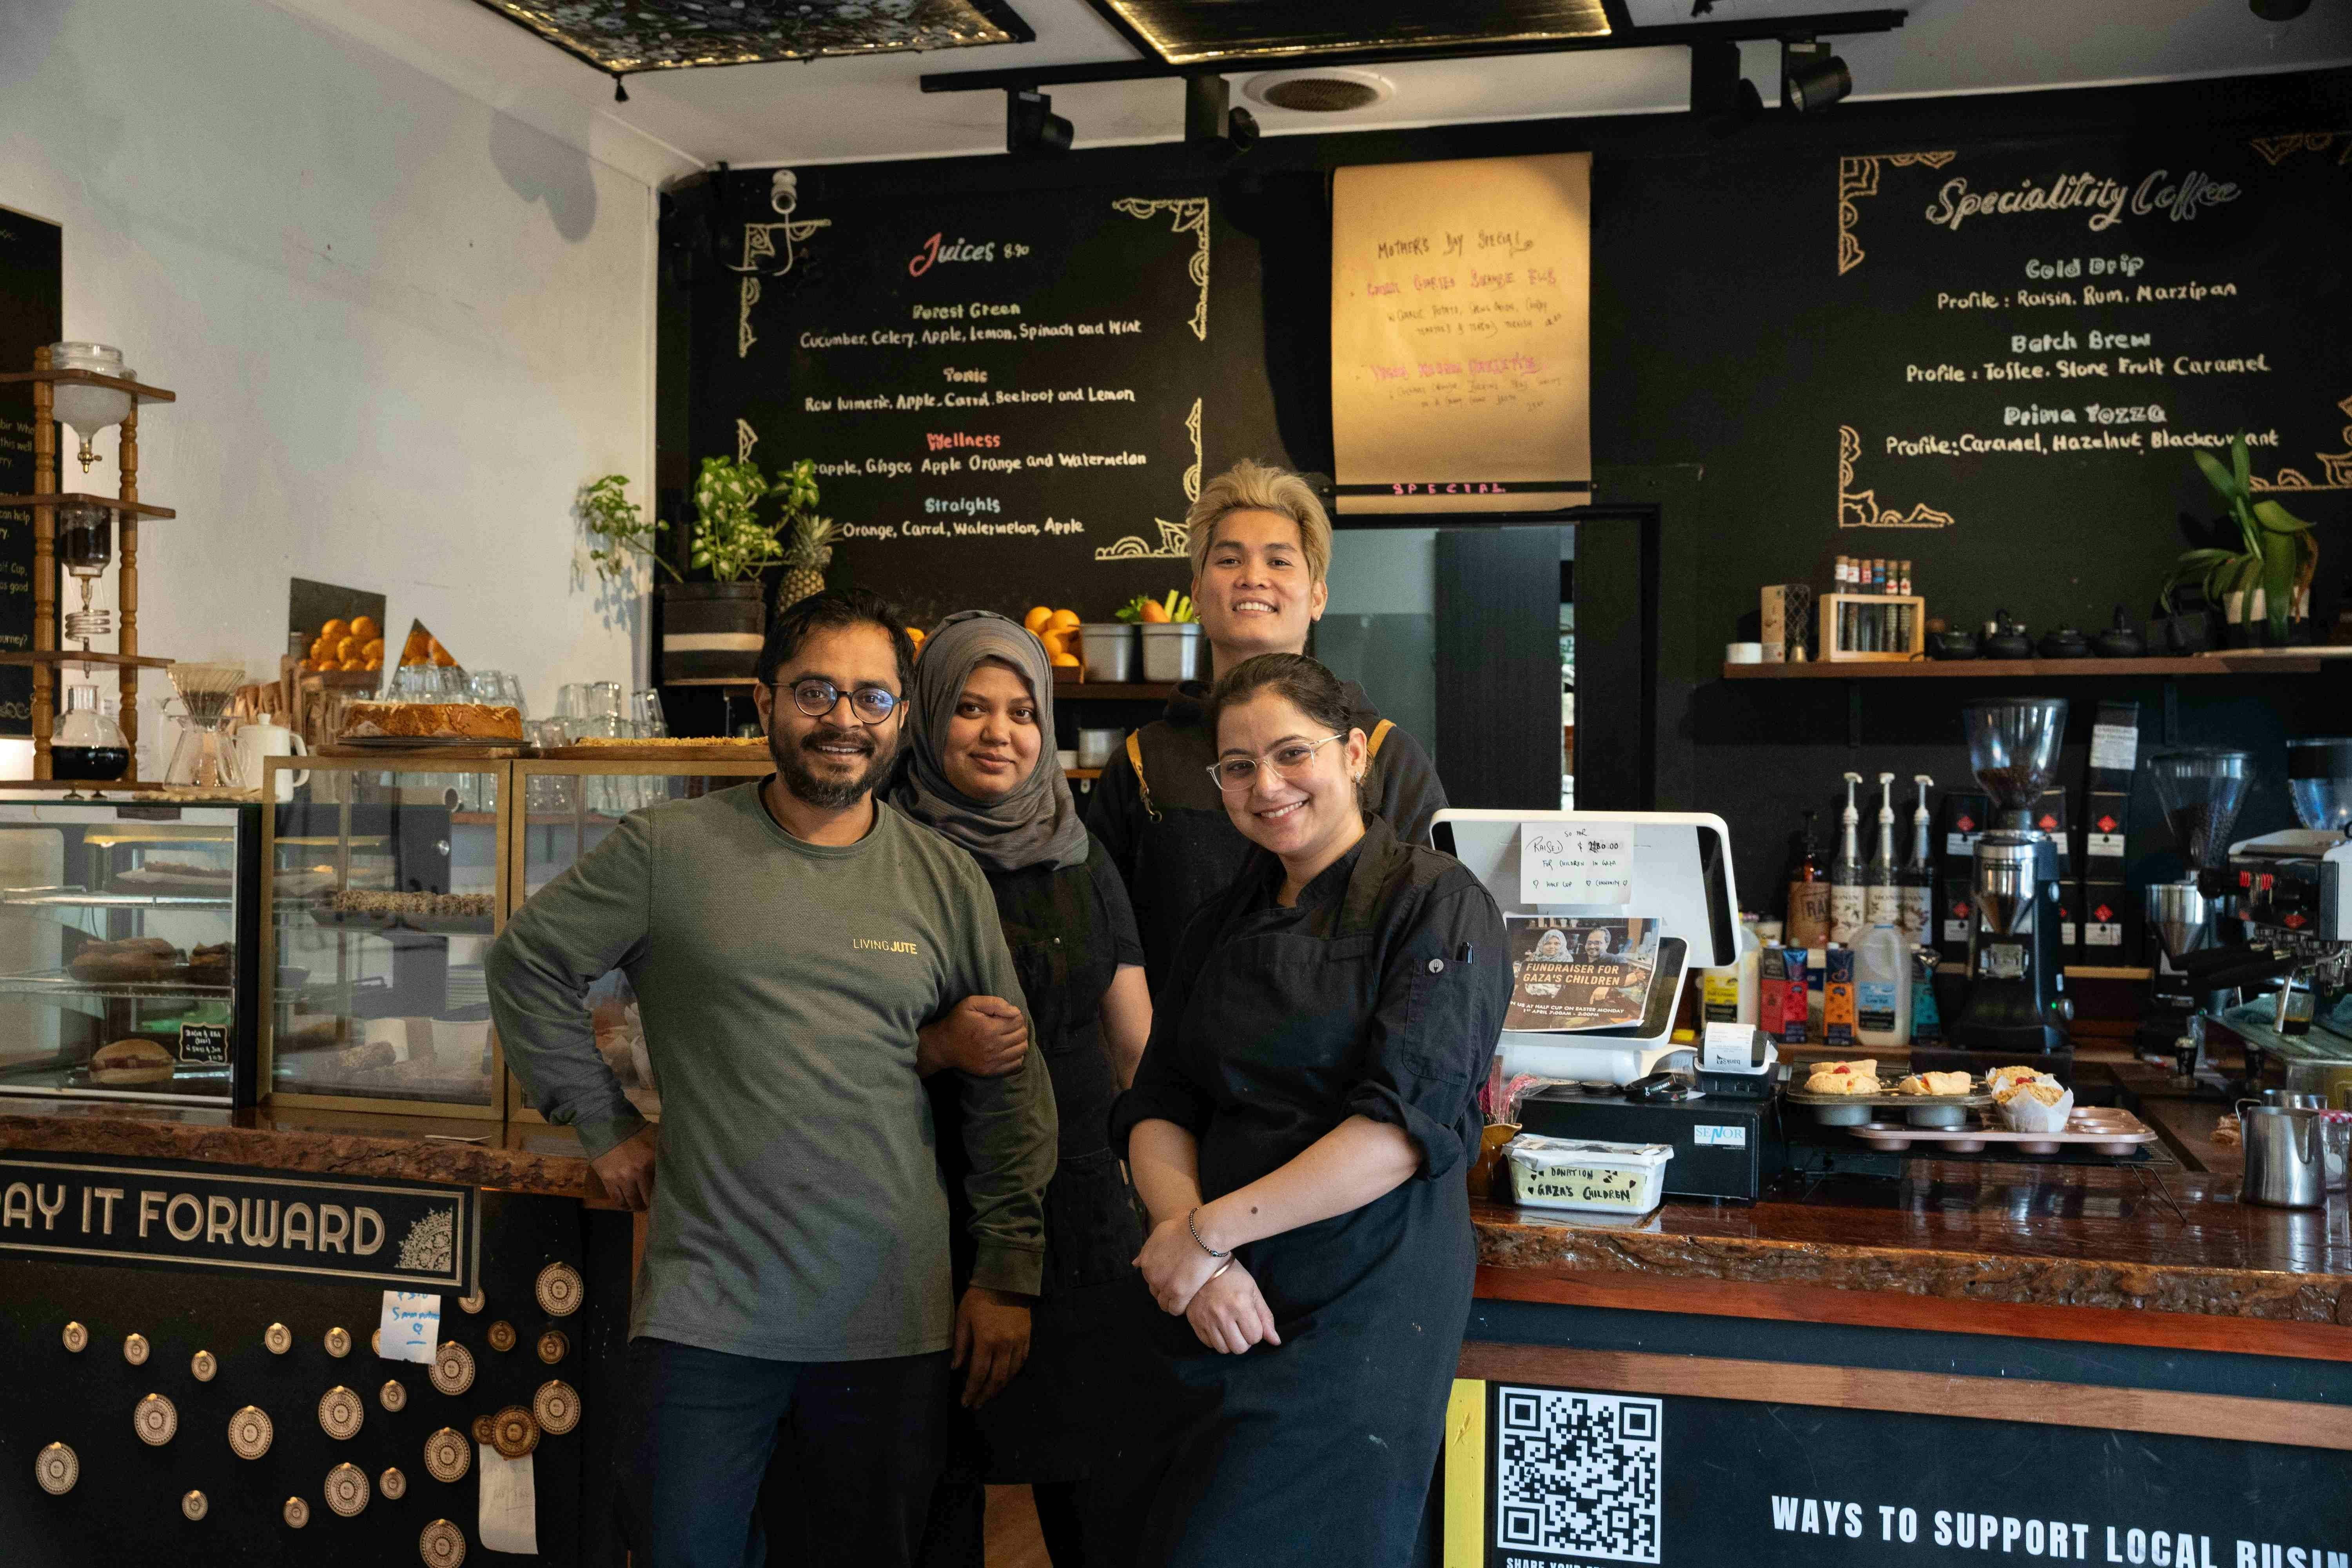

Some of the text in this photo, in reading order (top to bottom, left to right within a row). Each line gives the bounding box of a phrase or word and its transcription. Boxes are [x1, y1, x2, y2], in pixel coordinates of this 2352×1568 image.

[2131, 170, 2242, 221] Coffee
[909, 232, 995, 276] Juices
[2025, 254, 2144, 279] Cold Drip
[2136, 281, 2237, 301] Marzipan
[912, 302, 1020, 319] Forest Green
[1020, 323, 1074, 340] Spinach
[1078, 322, 1104, 335] and
[1109, 320, 1141, 335] Mint
[2011, 330, 2151, 353] Batch Brew
[943, 367, 987, 383] Tonic
[2056, 359, 2108, 377] Stone
[2118, 357, 2165, 376] Fruit
[2173, 353, 2271, 375] Caramel
[995, 389, 1053, 404] Beetroot
[1058, 388, 1084, 401] and
[1088, 387, 1135, 402] Lemon
[2004, 403, 2076, 425] Prima
[926, 432, 1000, 451] Wellness
[2151, 428, 2279, 448] Blackcurant
[921, 457, 963, 475] Apple
[969, 455, 1022, 474] Orange
[1026, 454, 1053, 467] and
[1058, 451, 1147, 466] Watermelon
[925, 497, 1000, 516] Straights
[843, 523, 897, 540] Orange,
[1044, 517, 1084, 535] Apple
[1543, 860, 1553, 871] FOR
[1526, 963, 1619, 974] FUNDRAISER FOR
[1523, 973, 1620, 985] GAZA'S CHILDREN
[1696, 1126, 1743, 1144] SENOR
[1551, 1167, 1593, 1180] DONATION
[1583, 1186, 1630, 1202] CHILDREN
[0, 1181, 385, 1256] AY IT FORWARD
[1772, 1495, 1862, 1537] WAYS
[1879, 1506, 1917, 1543] TO
[1934, 1510, 2089, 1559] SUPPORT
[2107, 1526, 2217, 1568] LOCAL
